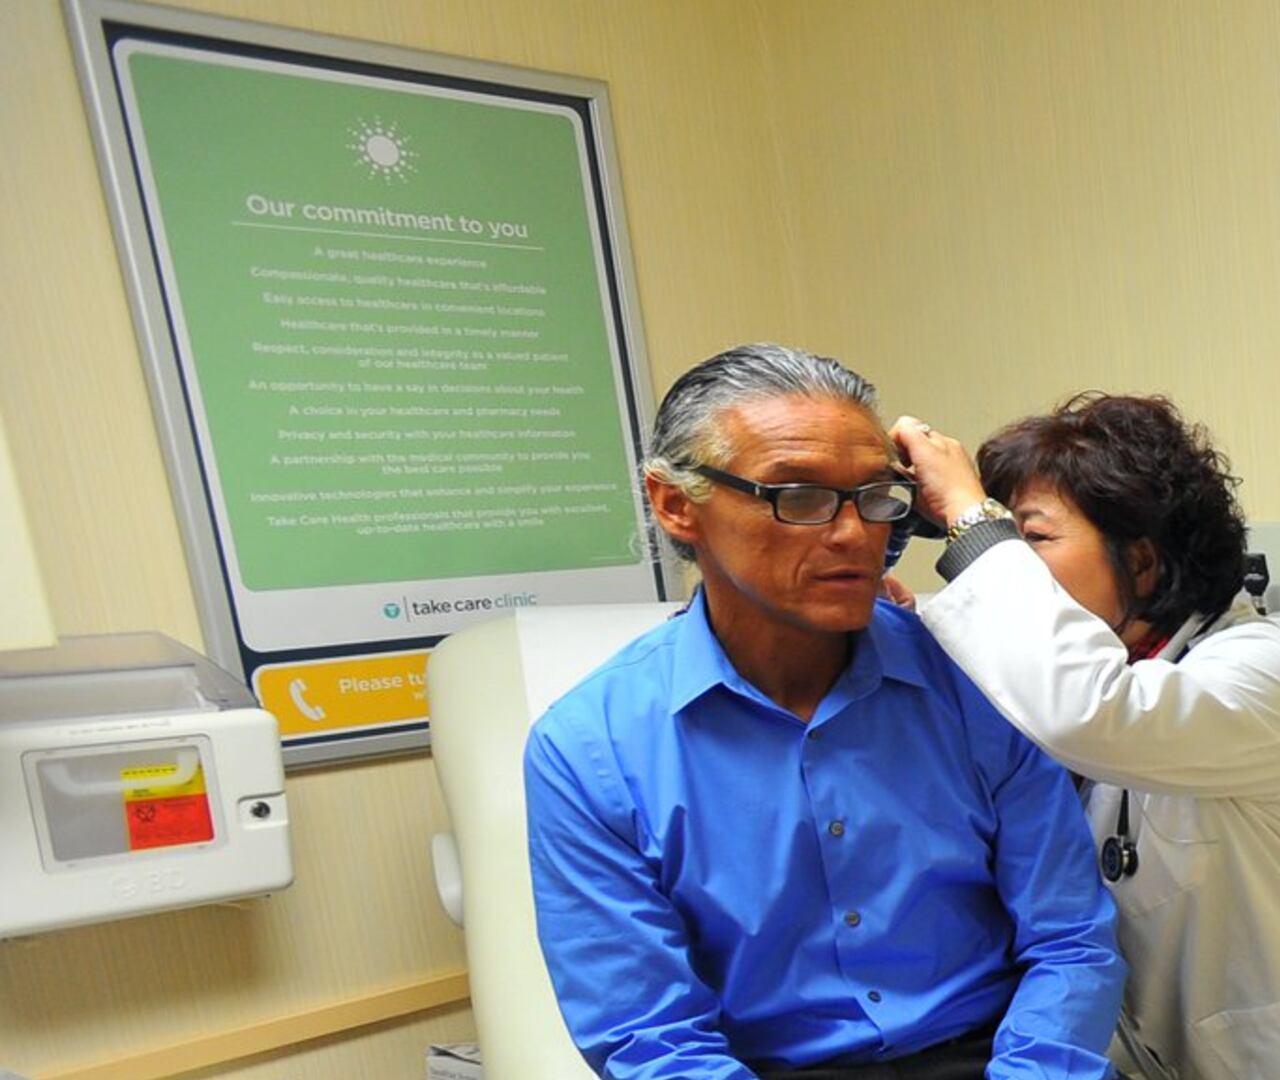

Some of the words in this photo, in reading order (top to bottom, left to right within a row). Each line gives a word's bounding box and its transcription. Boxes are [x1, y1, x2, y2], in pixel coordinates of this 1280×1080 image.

[246, 195, 295, 217] Our
[303, 204, 456, 231] commitment
[459, 216, 484, 234] to
[488, 221, 528, 239] you
[328, 247, 360, 261] great
[362, 250, 422, 263] healthcare
[250, 267, 352, 285] Compassionate,
[354, 274, 396, 288] quality
[398, 276, 456, 289] healthcare
[262, 294, 294, 306] Easy
[296, 297, 338, 306] access
[356, 298, 418, 310] healthcare
[280, 318, 346, 330] Healthcare
[386, 322, 438, 336] provided
[464, 326, 496, 338] timely
[312, 344, 392, 355] consideration
[420, 347, 468, 360] integrity
[396, 359, 456, 369] healthcare
[270, 379, 344, 392] opportunity
[362, 381, 392, 391] have
[494, 383, 524, 393] about
[528, 386, 550, 395] your
[302, 406, 342, 415] choice
[360, 408, 386, 417] your
[390, 406, 450, 415] healthcare
[452, 406, 474, 415] and
[278, 429, 326, 441] Privacy
[328, 429, 352, 439] and
[354, 429, 400, 441] security
[404, 429, 430, 438] with
[432, 431, 456, 440] your
[458, 429, 514, 438] healthcare
[284, 454, 354, 466] partnership
[358, 454, 384, 463] with
[432, 465, 456, 473] care
[398, 487, 422, 497] that
[540, 485, 562, 495] your
[266, 515, 296, 526] Take
[298, 514, 328, 524] Care
[332, 512, 372, 523] Health
[422, 519, 480, 531] healthcare
[412, 601, 451, 616] take
[454, 596, 493, 612] care
[494, 592, 537, 609] clinic
[339, 674, 403, 694] Please
